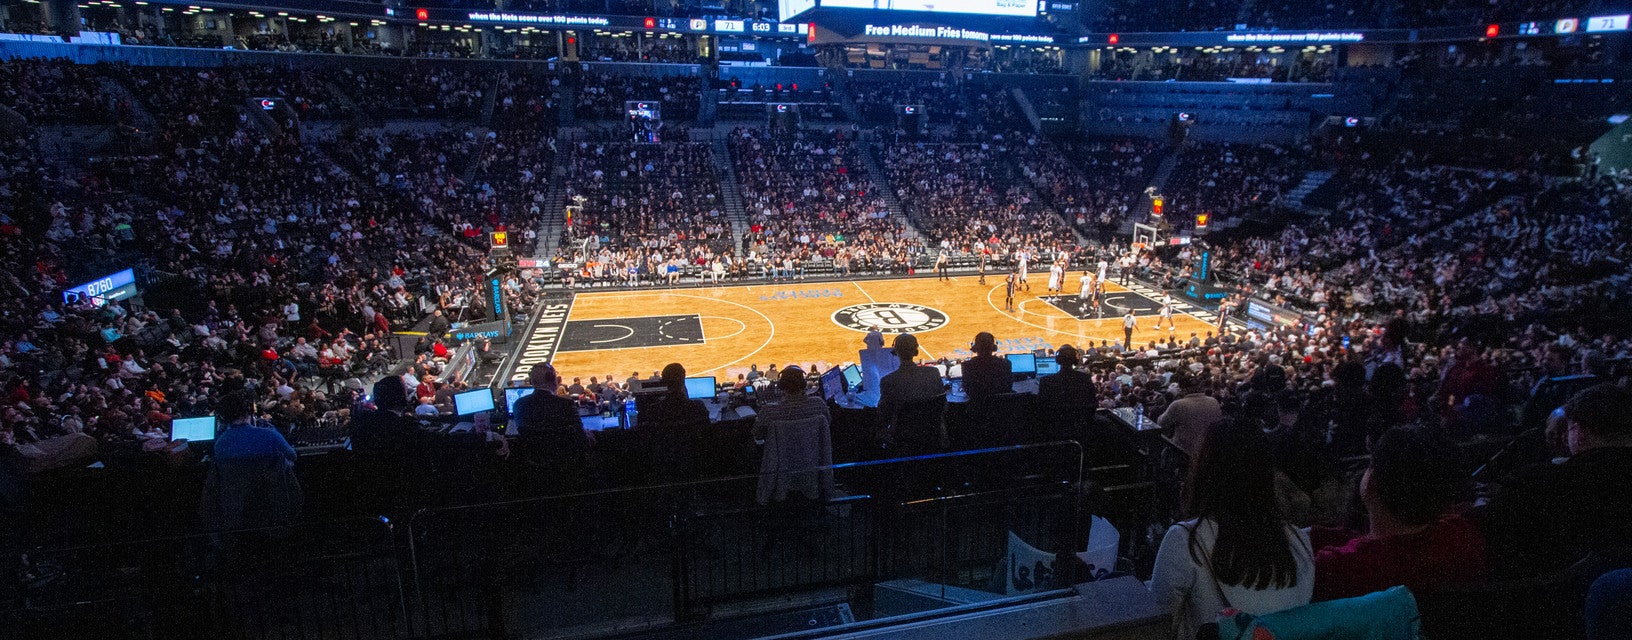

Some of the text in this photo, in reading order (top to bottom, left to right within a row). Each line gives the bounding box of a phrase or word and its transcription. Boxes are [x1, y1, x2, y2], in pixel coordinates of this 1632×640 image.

[468, 12, 489, 20] when
[489, 13, 500, 21] the
[566, 17, 588, 25] points
[588, 17, 609, 26] today.
[724, 22, 735, 30] 71
[1601, 19, 1615, 29] 71
[752, 23, 770, 31] 6:03
[865, 24, 890, 36] Free
[891, 25, 936, 37] Medium
[937, 27, 961, 39] Fries
[88, 278, 112, 296] 8760
[539, 304, 568, 323] NETS
